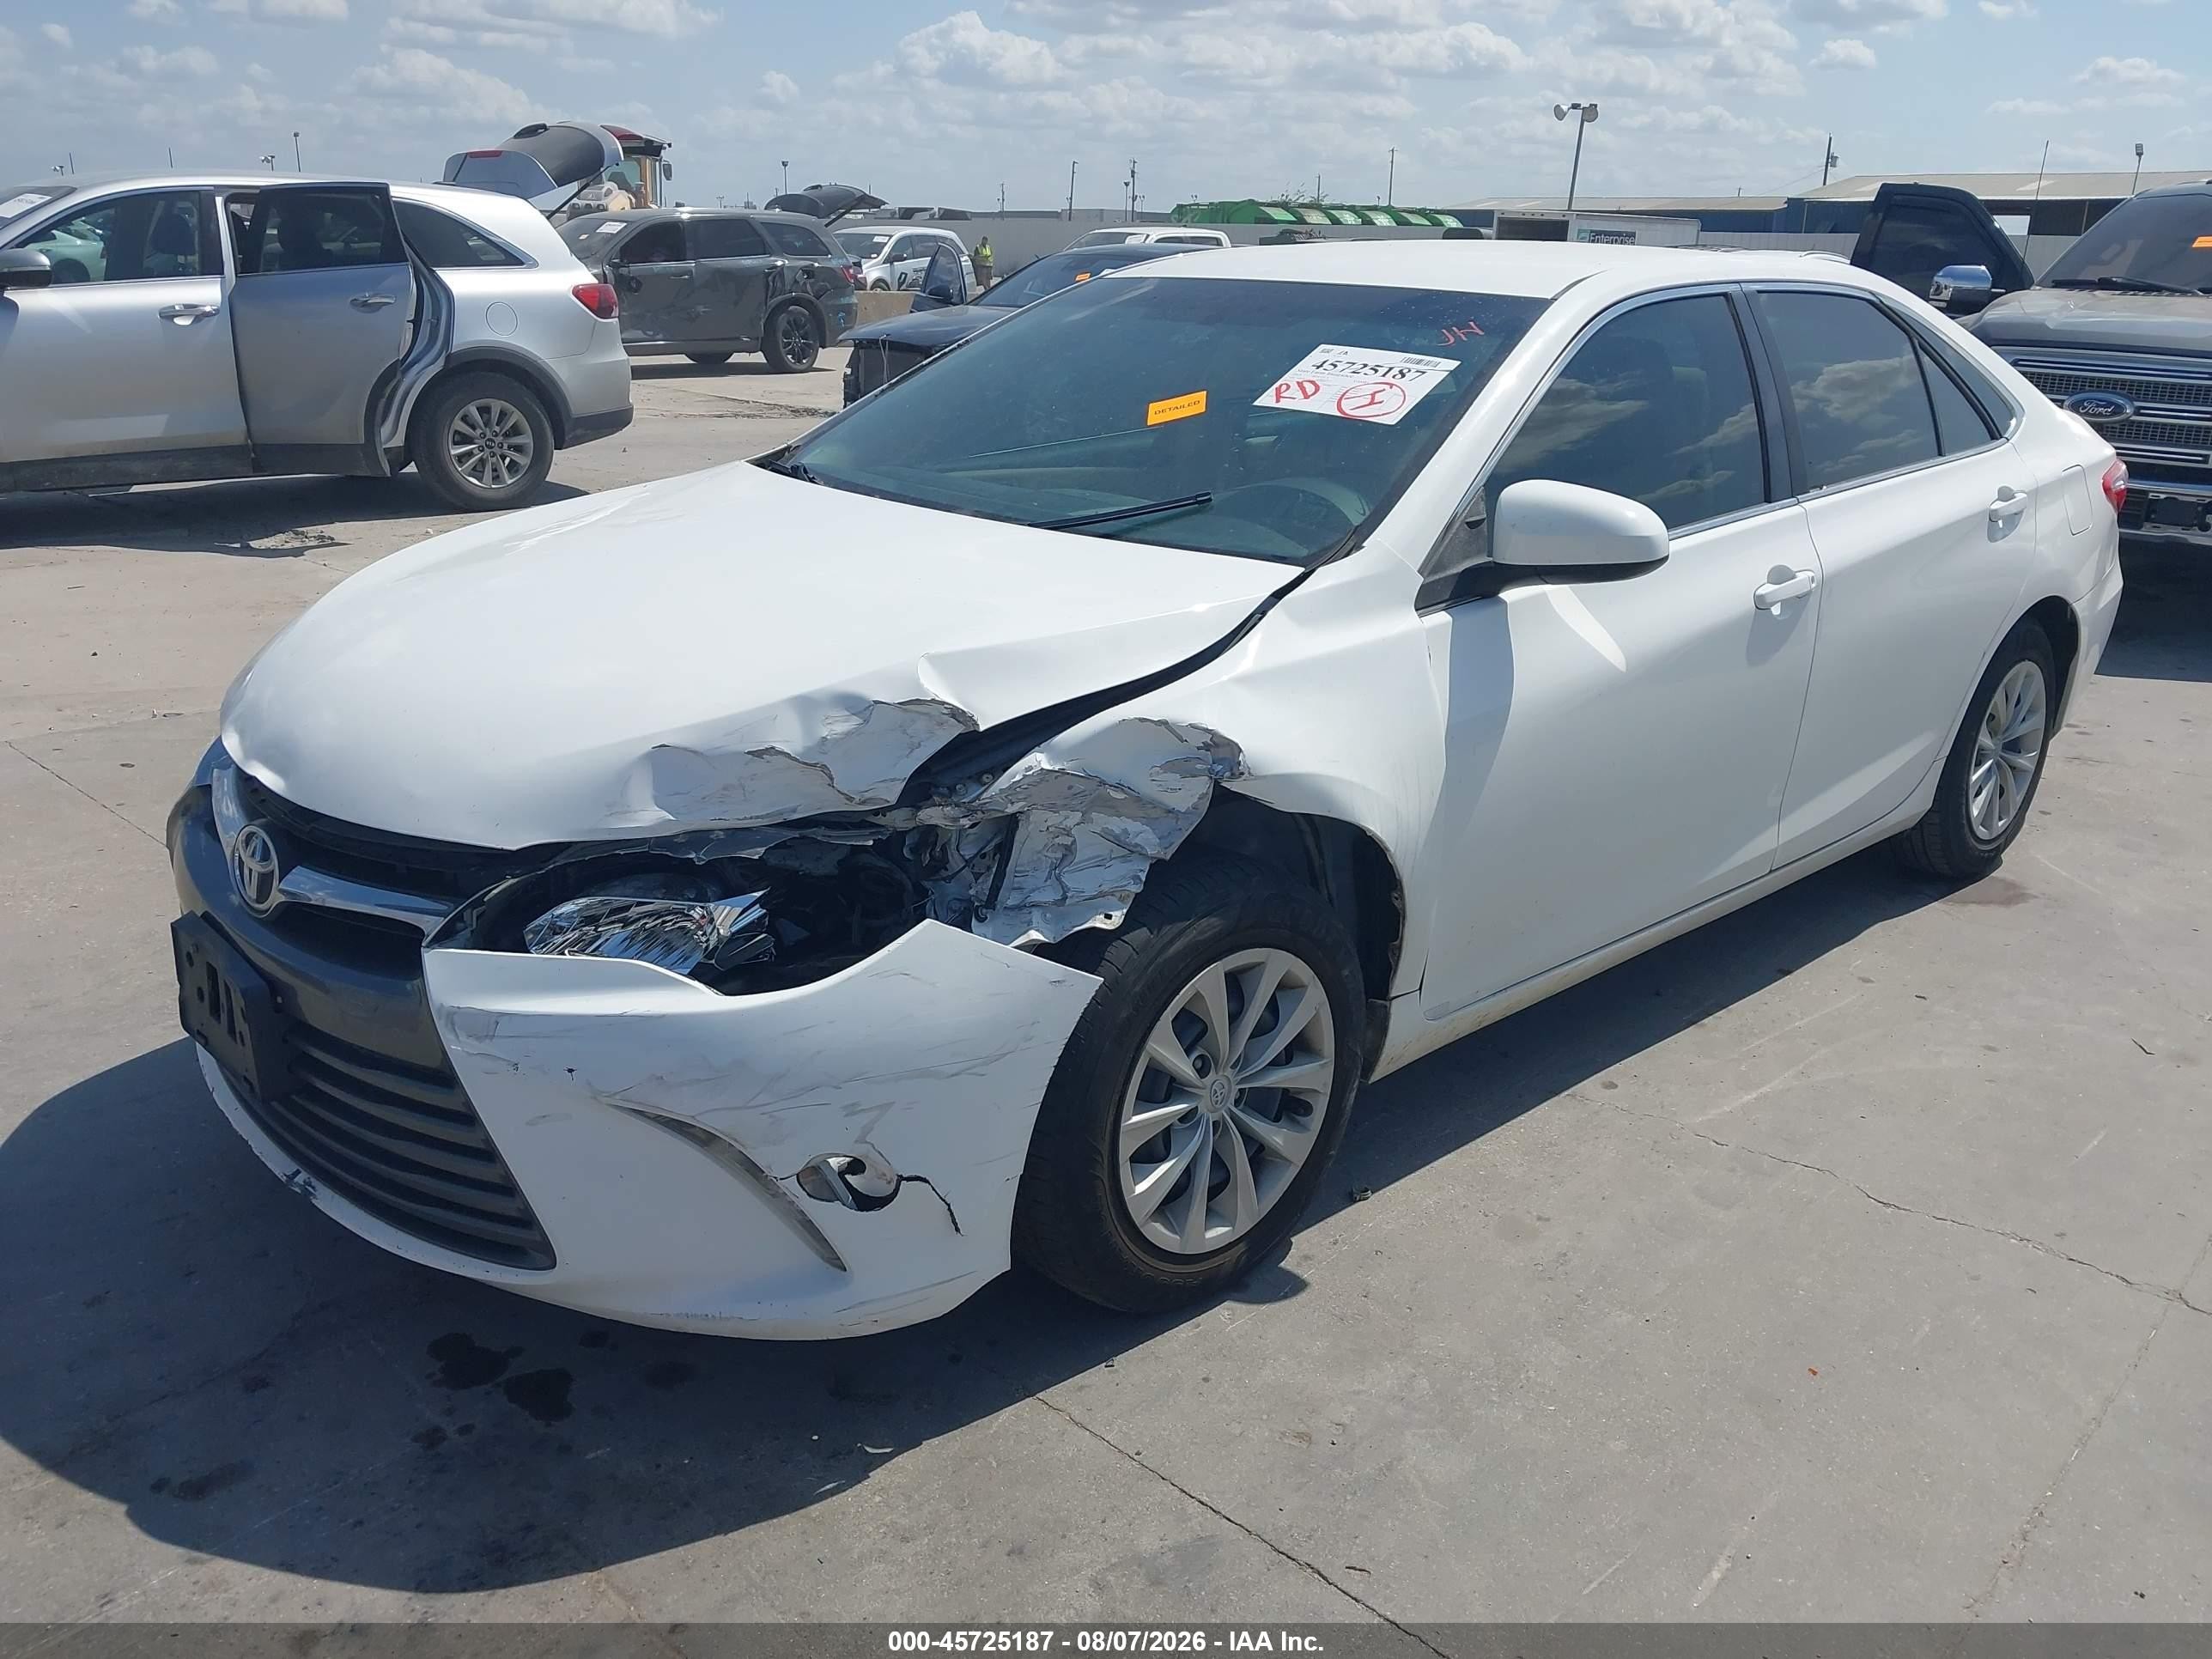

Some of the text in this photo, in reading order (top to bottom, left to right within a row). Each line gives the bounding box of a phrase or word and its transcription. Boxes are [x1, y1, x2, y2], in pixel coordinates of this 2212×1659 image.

[1589, 233, 1635, 245] Enterprise
[1311, 359, 1428, 381] 45725187
[1275, 380, 1320, 404] RD
[1154, 399, 1200, 416] DETAILED
[2079, 399, 2115, 416] Ford
